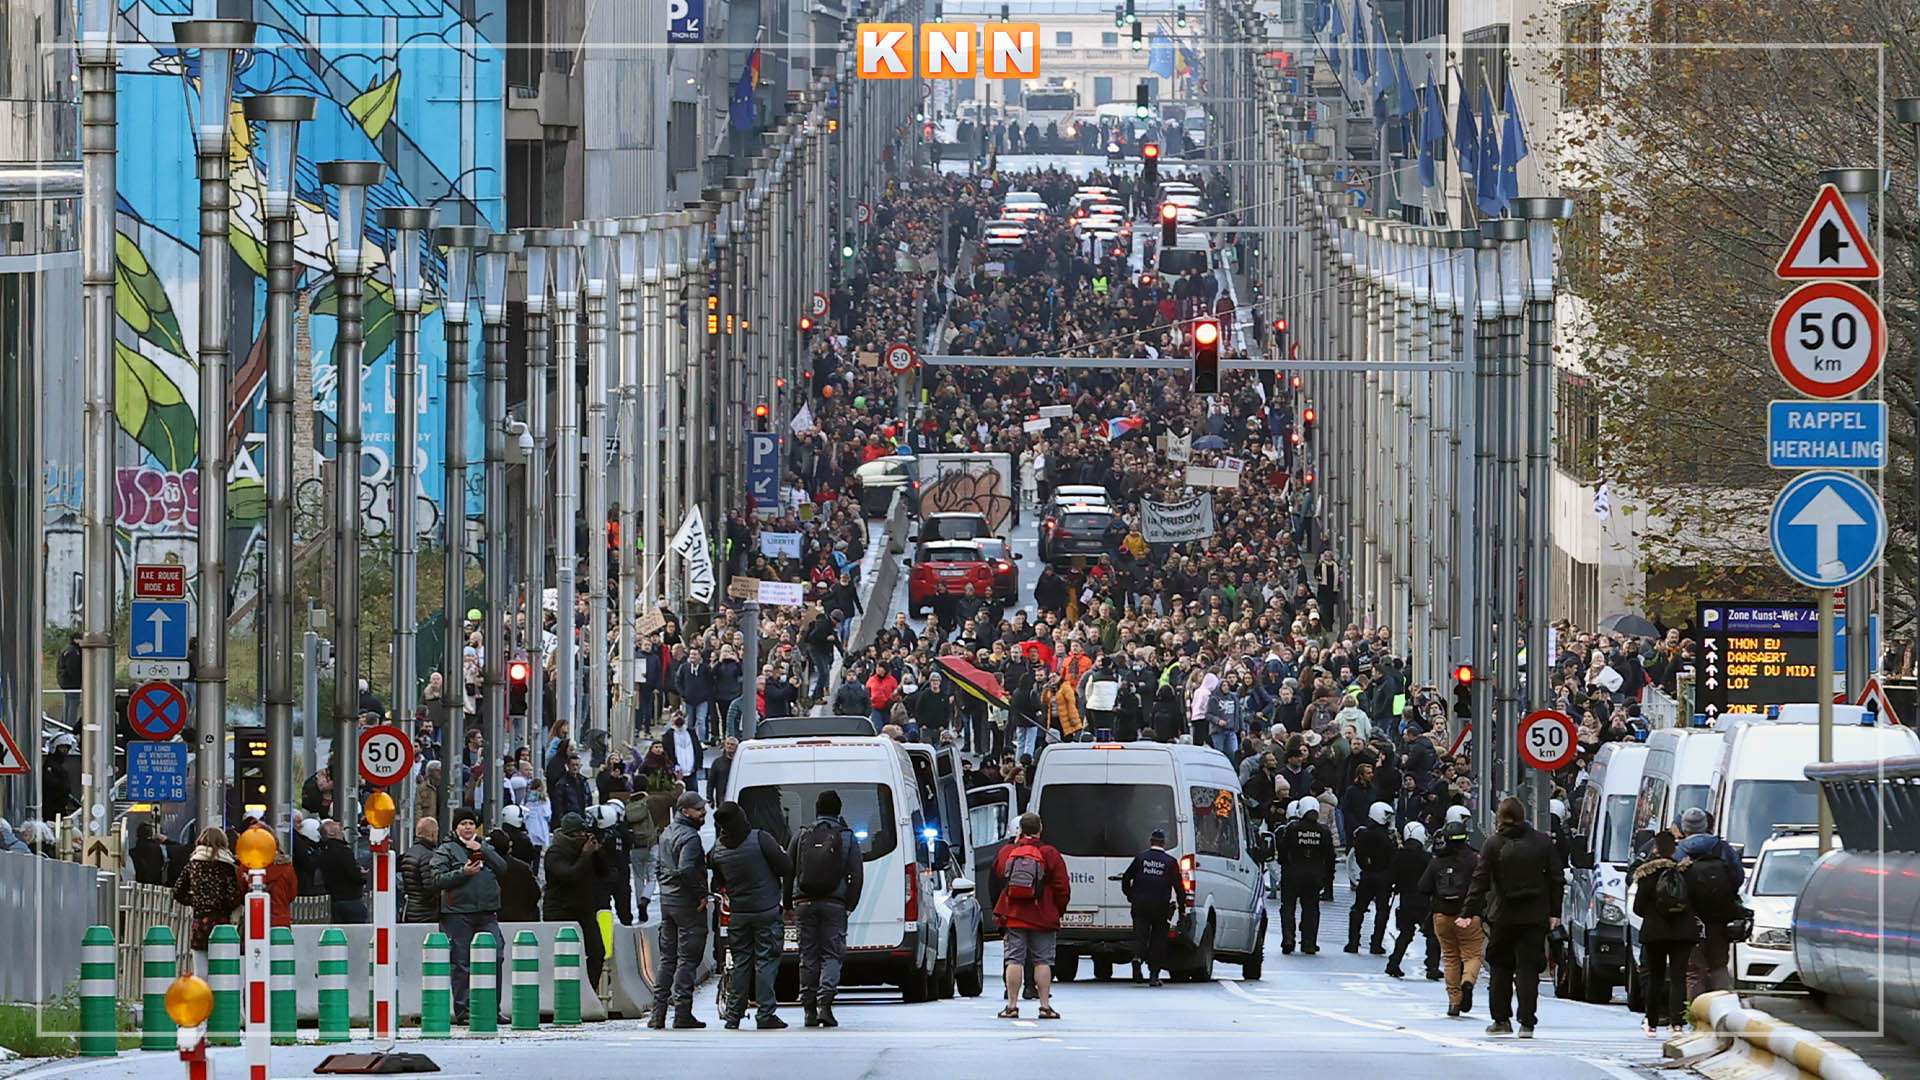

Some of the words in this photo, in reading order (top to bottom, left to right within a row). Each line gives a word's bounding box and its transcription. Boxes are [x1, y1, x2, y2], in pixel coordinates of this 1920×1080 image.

[667, 0, 689, 31] P
[1799, 312, 1857, 351] 50
[892, 352, 908, 362] 50
[1814, 356, 1842, 371] km
[1788, 411, 1867, 429] RAPPEL
[753, 437, 774, 465] P
[1772, 440, 1883, 459] HERHALING
[140, 571, 155, 580] AXE
[166, 583, 176, 592] AS
[1728, 609, 1750, 621] Zone
[1752, 609, 1799, 621] Kunst-Wet
[1727, 638, 1758, 650] THON
[1763, 638, 1782, 650] EU
[1727, 651, 1788, 663] DANSAERT
[1727, 665, 1758, 676] GARE
[1764, 665, 1781, 676] DU
[1786, 665, 1816, 677] MIDI
[1727, 678, 1750, 689] LOI
[1726, 704, 1758, 714] ZONE
[1532, 726, 1563, 747] 50
[368, 742, 399, 762] 50
[1539, 748, 1556, 758] km
[375, 764, 392, 773] km
[145, 775, 153, 785] 7
[171, 775, 183, 786] 13
[143, 788, 155, 798] 16
[171, 788, 183, 798] 18
[1143, 860, 1166, 868] Politie
[1143, 867, 1164, 876] Police
[1070, 872, 1095, 884] litie
